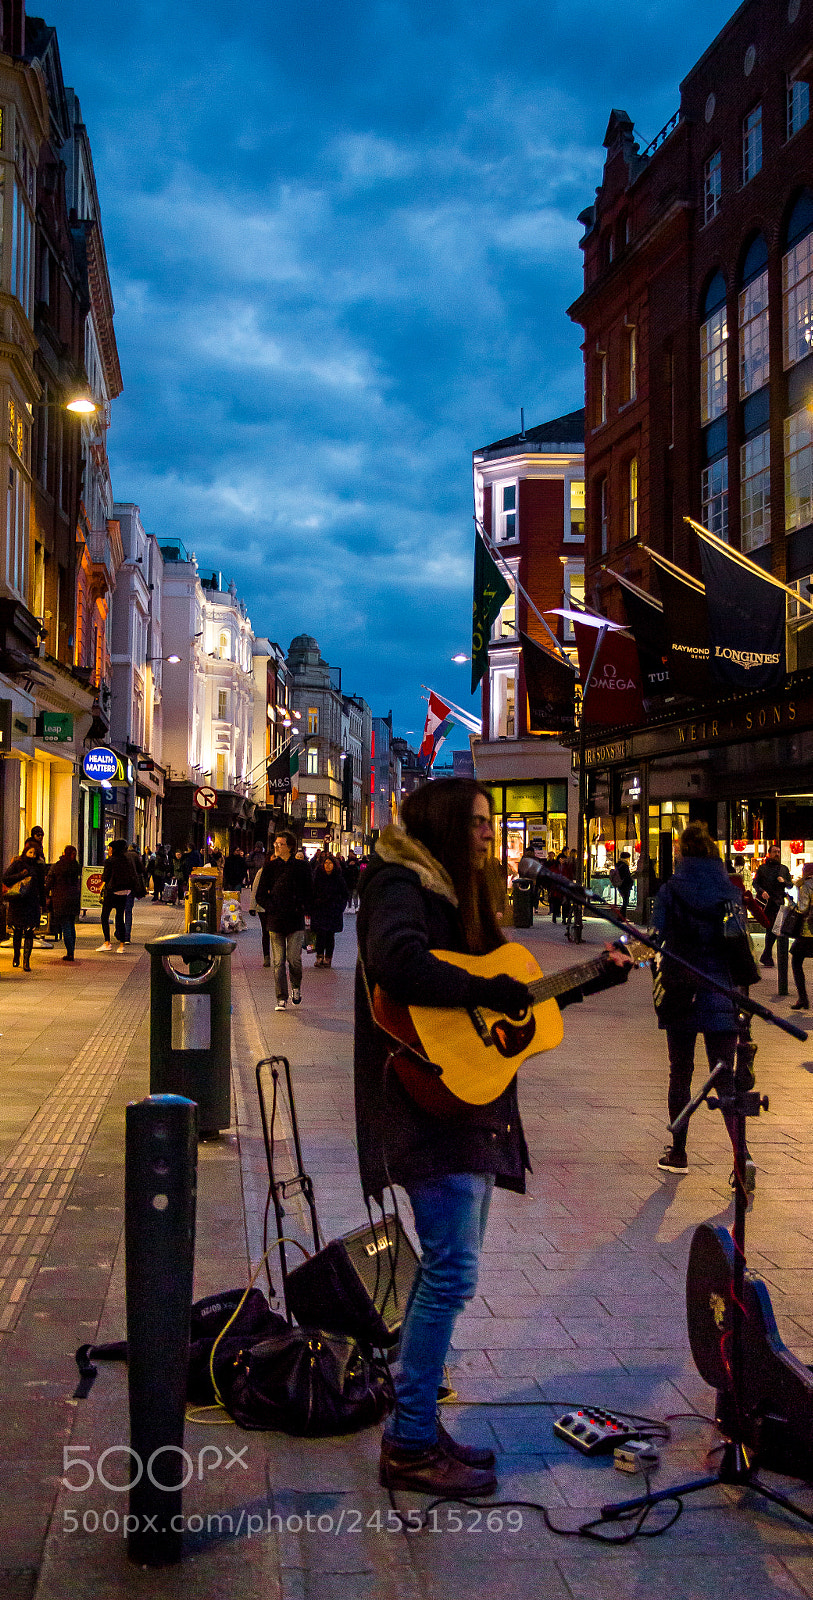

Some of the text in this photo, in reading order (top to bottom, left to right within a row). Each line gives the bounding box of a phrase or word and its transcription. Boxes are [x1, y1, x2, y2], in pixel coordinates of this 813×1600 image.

[671, 643, 710, 655] RAYMOND
[714, 646, 780, 664] LONGINES
[589, 676, 636, 690] OMEGA
[678, 702, 796, 743] WEIR SONS
[44, 725, 62, 734] Leap
[88, 755, 113, 764] HEALTH
[85, 763, 116, 773] MATTERS
[269, 776, 290, 788] M&S
